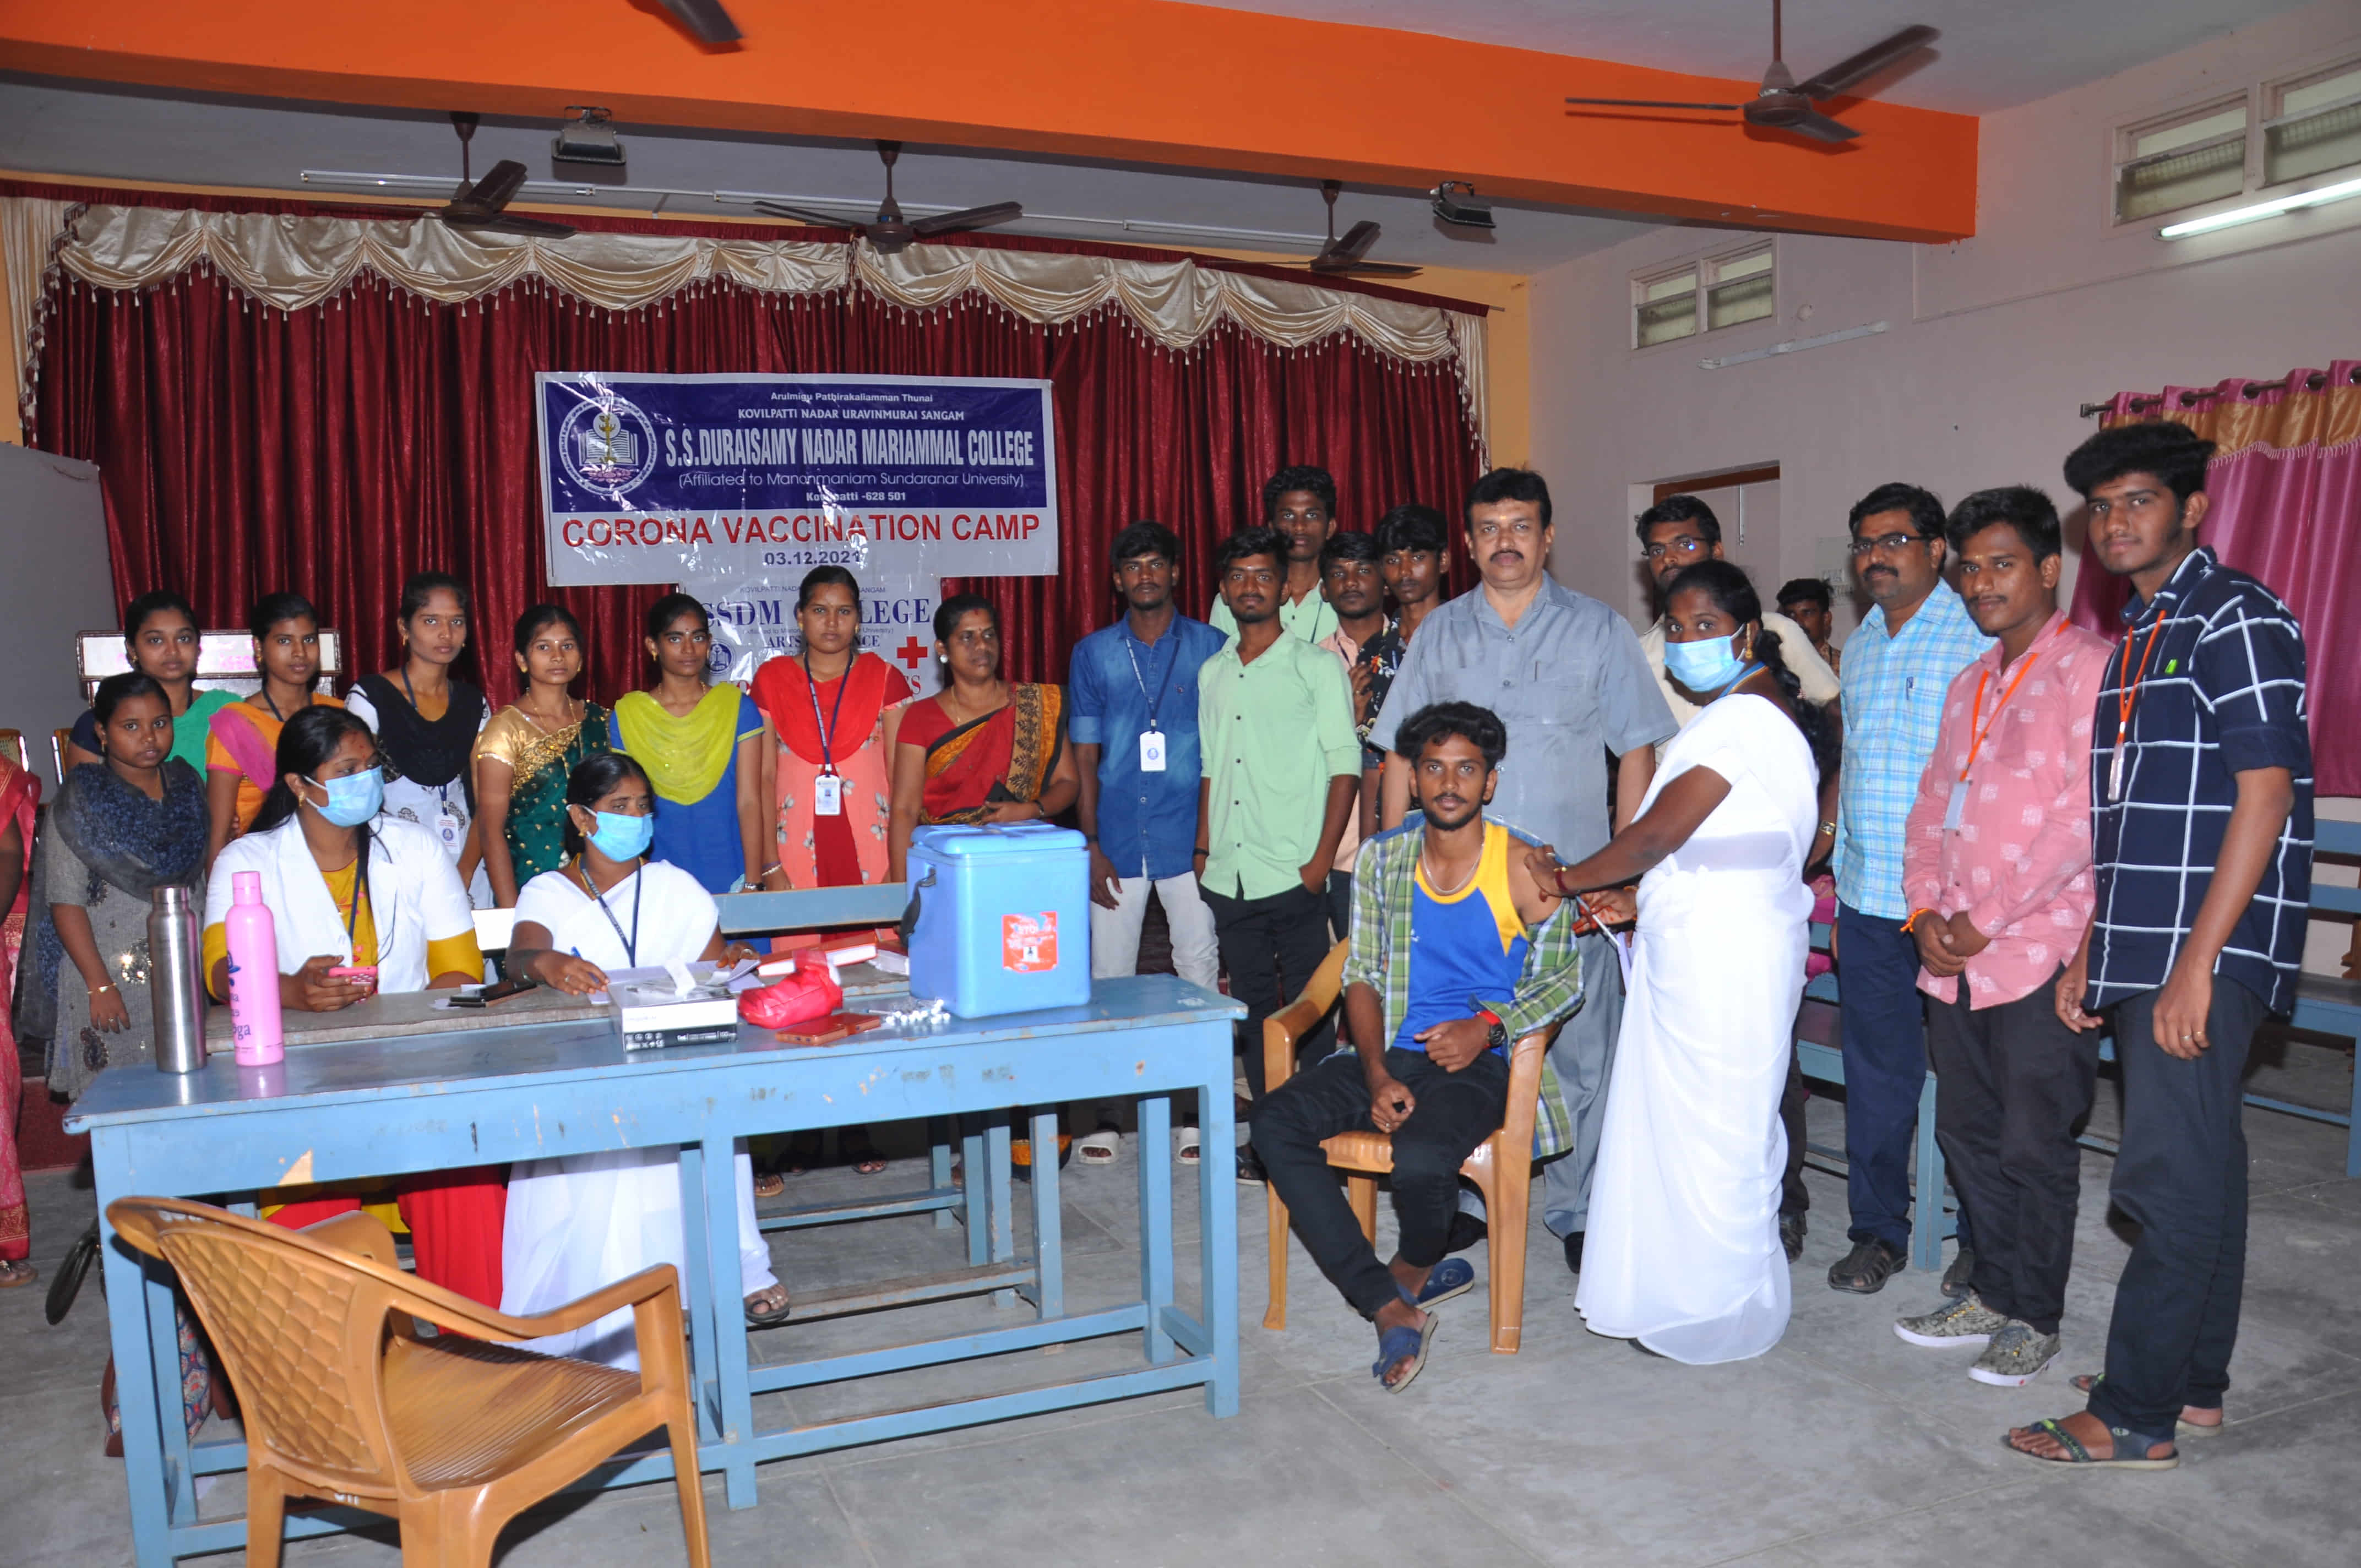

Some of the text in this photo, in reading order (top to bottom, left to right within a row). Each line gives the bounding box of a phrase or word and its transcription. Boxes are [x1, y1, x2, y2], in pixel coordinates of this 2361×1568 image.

[901, 394, 933, 402] Thunai
[738, 409, 964, 421] KOVILPATTI NADAR URAVINMURAI SANGAM
[665, 428, 1034, 466] S.S.DURAISAMY NADAR MARIAMMAL COLLEGE
[679, 472, 1024, 488] (Affiliated to Manonmaniam Sundaranar University)
[888, 492, 906, 501] 501
[562, 514, 1040, 547] CORONA VACCINATION CAMP
[764, 551, 860, 565] 03.12.2021
